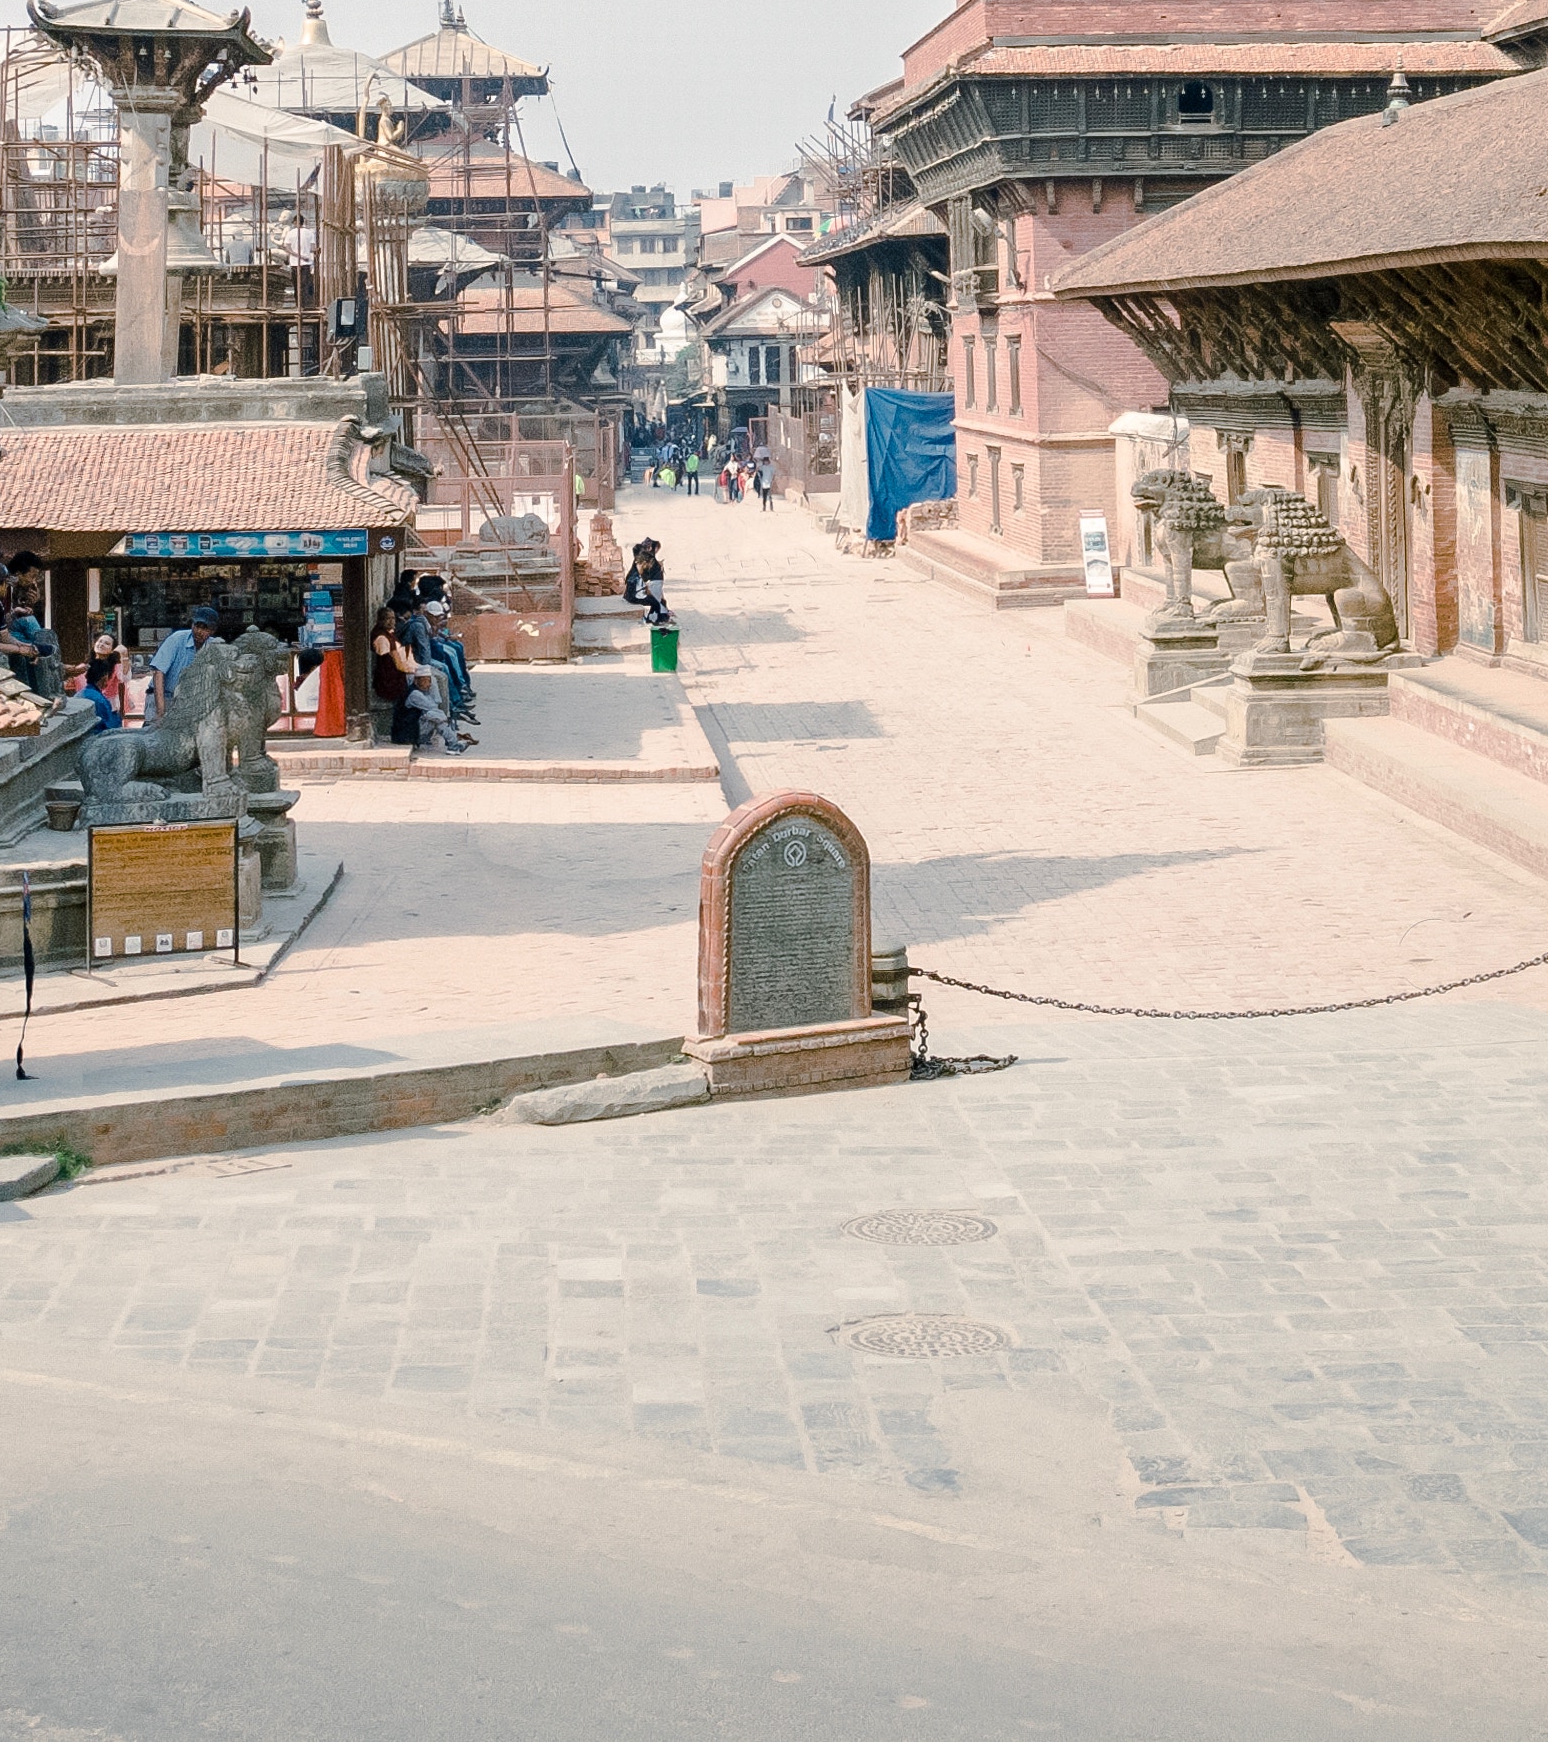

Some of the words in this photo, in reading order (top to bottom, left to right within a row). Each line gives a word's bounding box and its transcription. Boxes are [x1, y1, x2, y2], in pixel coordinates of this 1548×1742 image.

[741, 842, 771, 873] Patan
[771, 825, 812, 843] Durbar
[816, 833, 846, 869] Square
